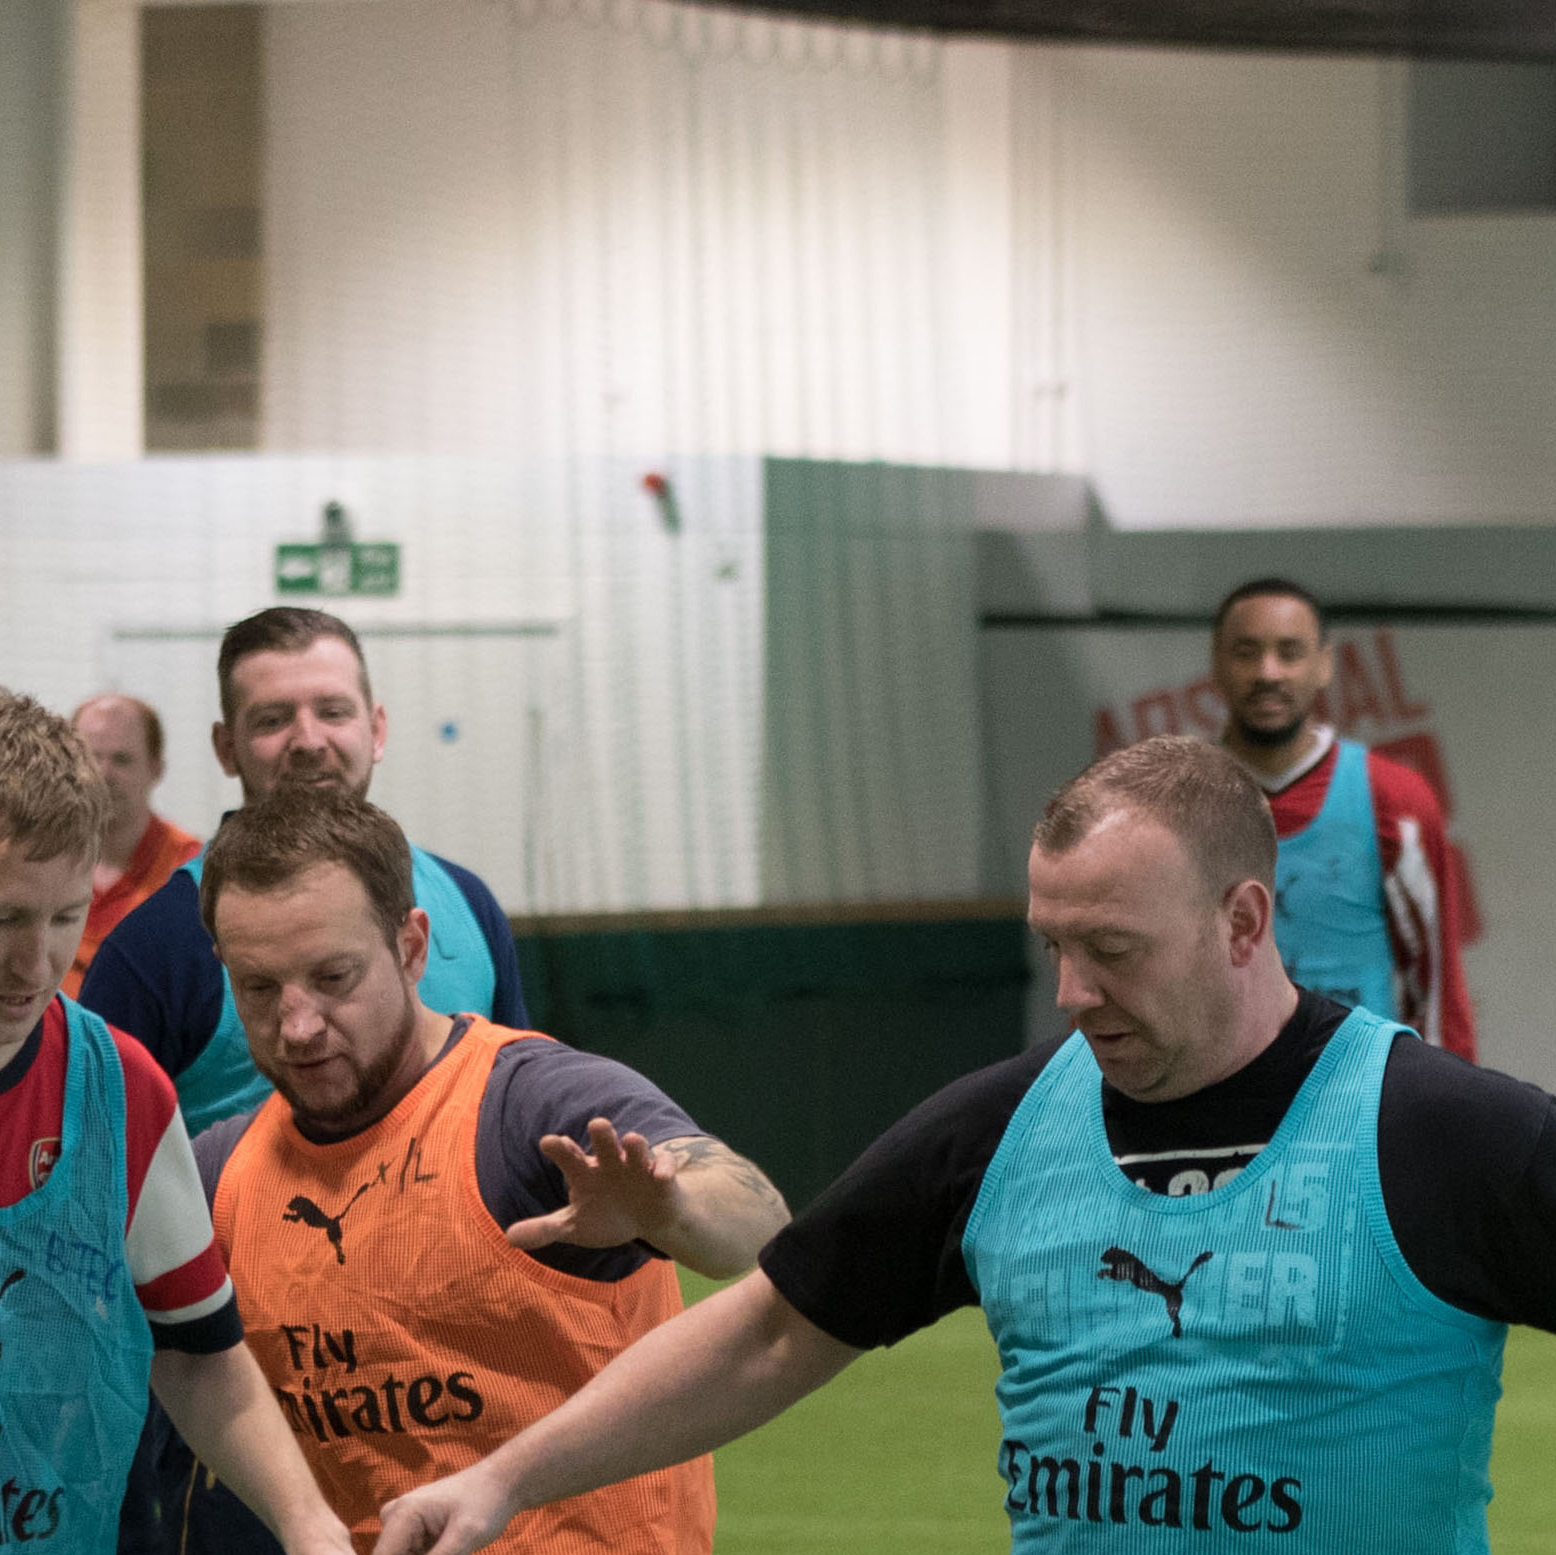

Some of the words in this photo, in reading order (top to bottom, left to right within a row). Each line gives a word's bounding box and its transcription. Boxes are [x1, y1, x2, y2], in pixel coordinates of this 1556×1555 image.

[281, 1322, 357, 1374] Fly
[1083, 1386, 1179, 1453] Fly
[1002, 1439, 1303, 1533] Emirates
